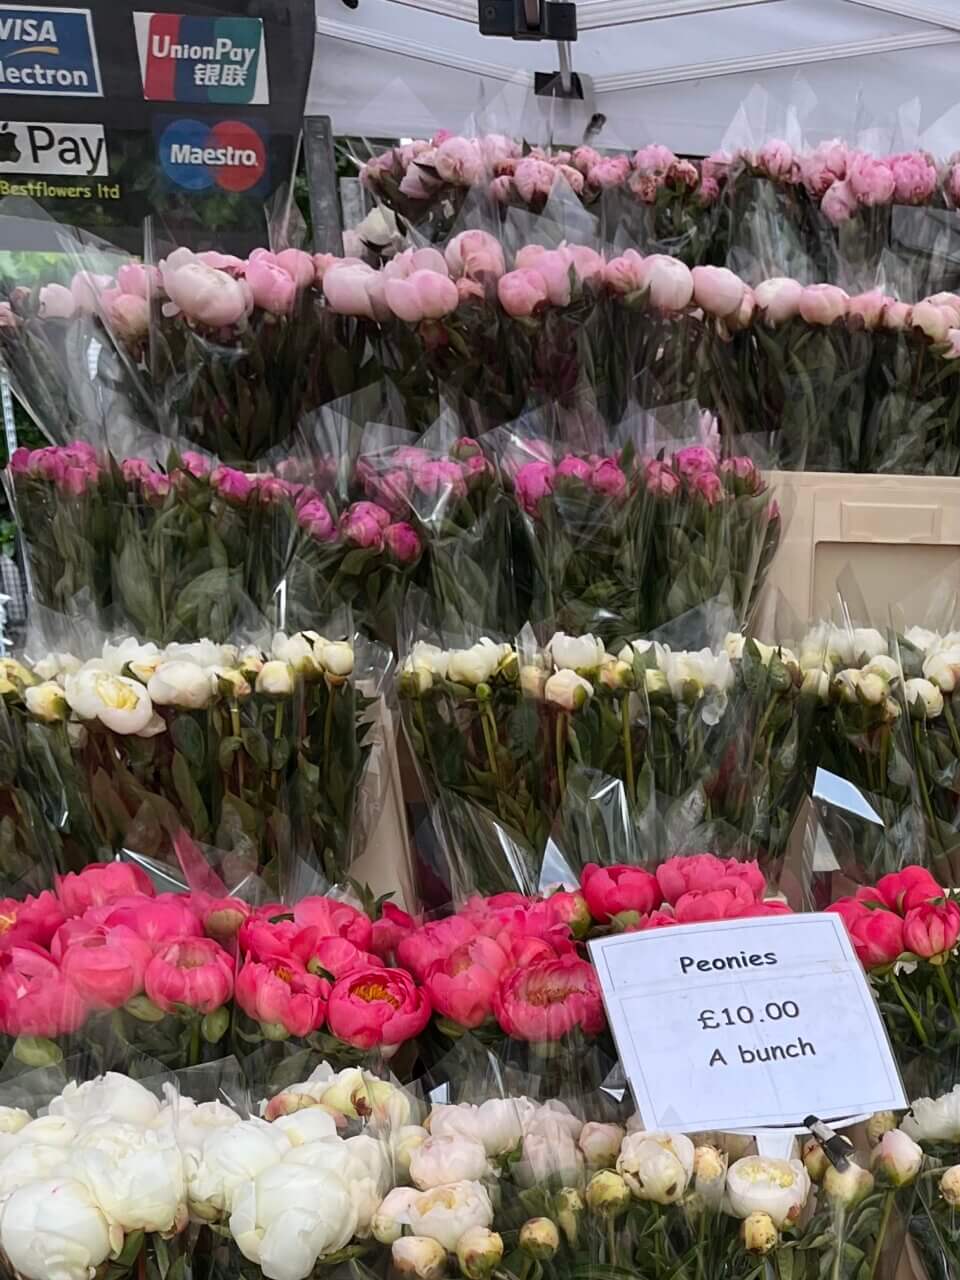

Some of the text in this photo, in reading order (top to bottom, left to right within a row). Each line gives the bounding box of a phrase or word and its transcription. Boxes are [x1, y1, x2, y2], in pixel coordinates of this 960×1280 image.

[0, 18, 57, 42] VISA
[152, 35, 256, 71] UnionPay
[0, 60, 88, 87] lectron
[194, 63, 247, 86] 银联
[27, 125, 104, 175] Pay
[170, 144, 258, 166] Maestro
[97, 183, 120, 198] ltd
[679, 951, 778, 975] Peonies
[697, 1000, 800, 1030] £10.00
[709, 1037, 816, 1067] A bunch
